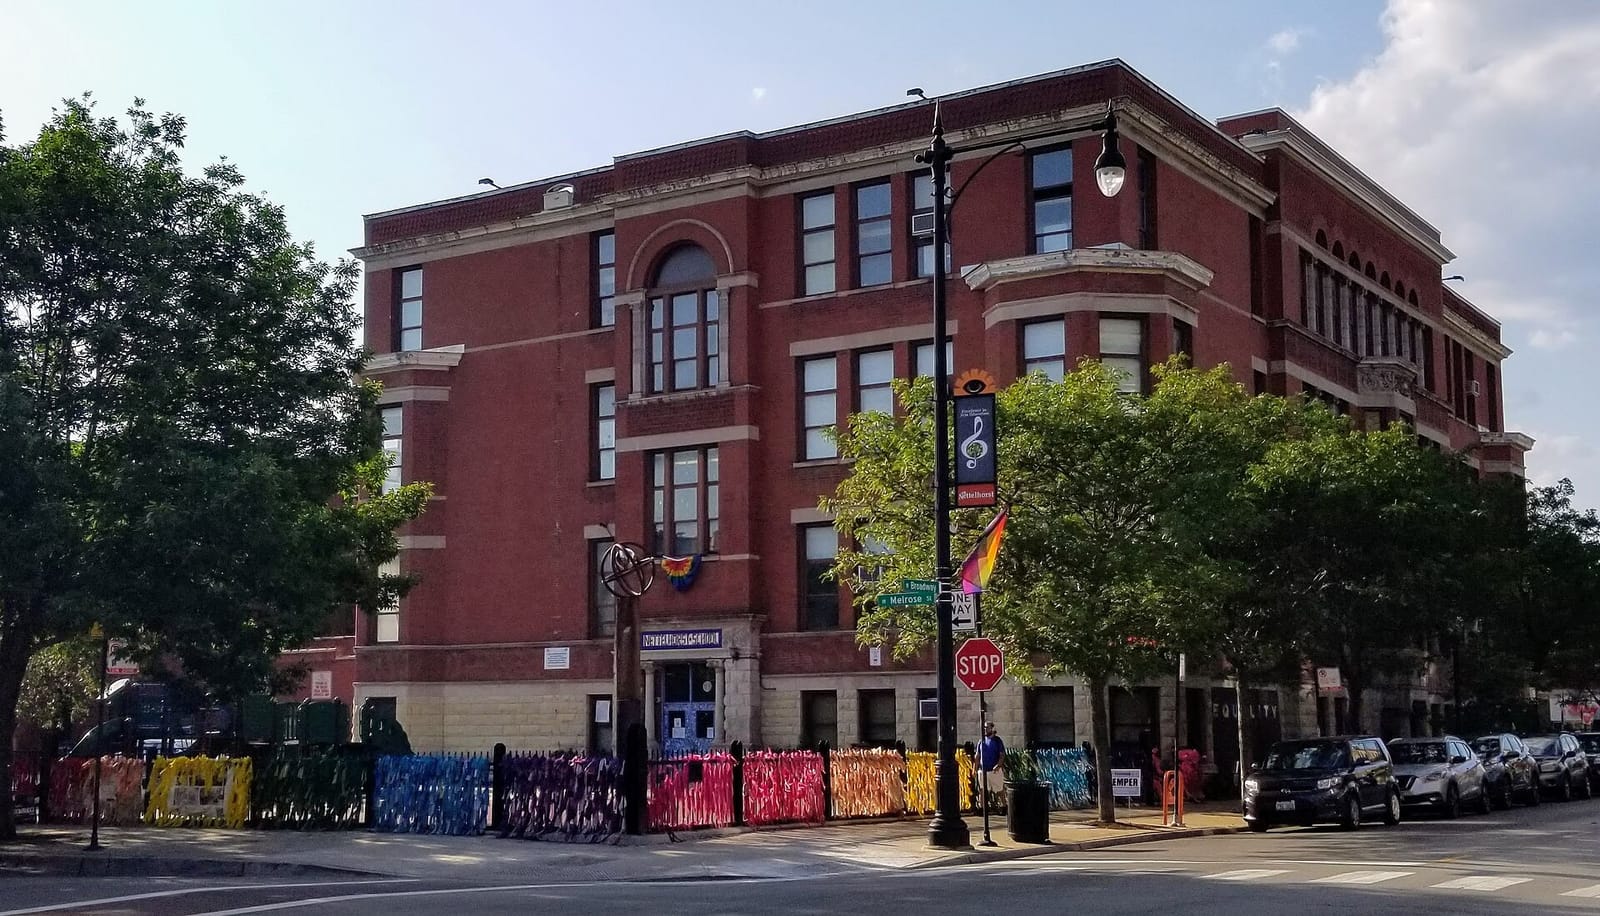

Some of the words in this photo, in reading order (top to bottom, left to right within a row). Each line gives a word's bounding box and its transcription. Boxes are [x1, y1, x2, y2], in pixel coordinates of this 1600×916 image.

[959, 491, 994, 499] Nettelhorst
[910, 581, 936, 593] Broadway
[890, 596, 922, 605] Melrose
[959, 654, 1000, 675] STOP
[1212, 703, 1277, 719] EQULITY
[1112, 778, 1138, 787] EMPER
